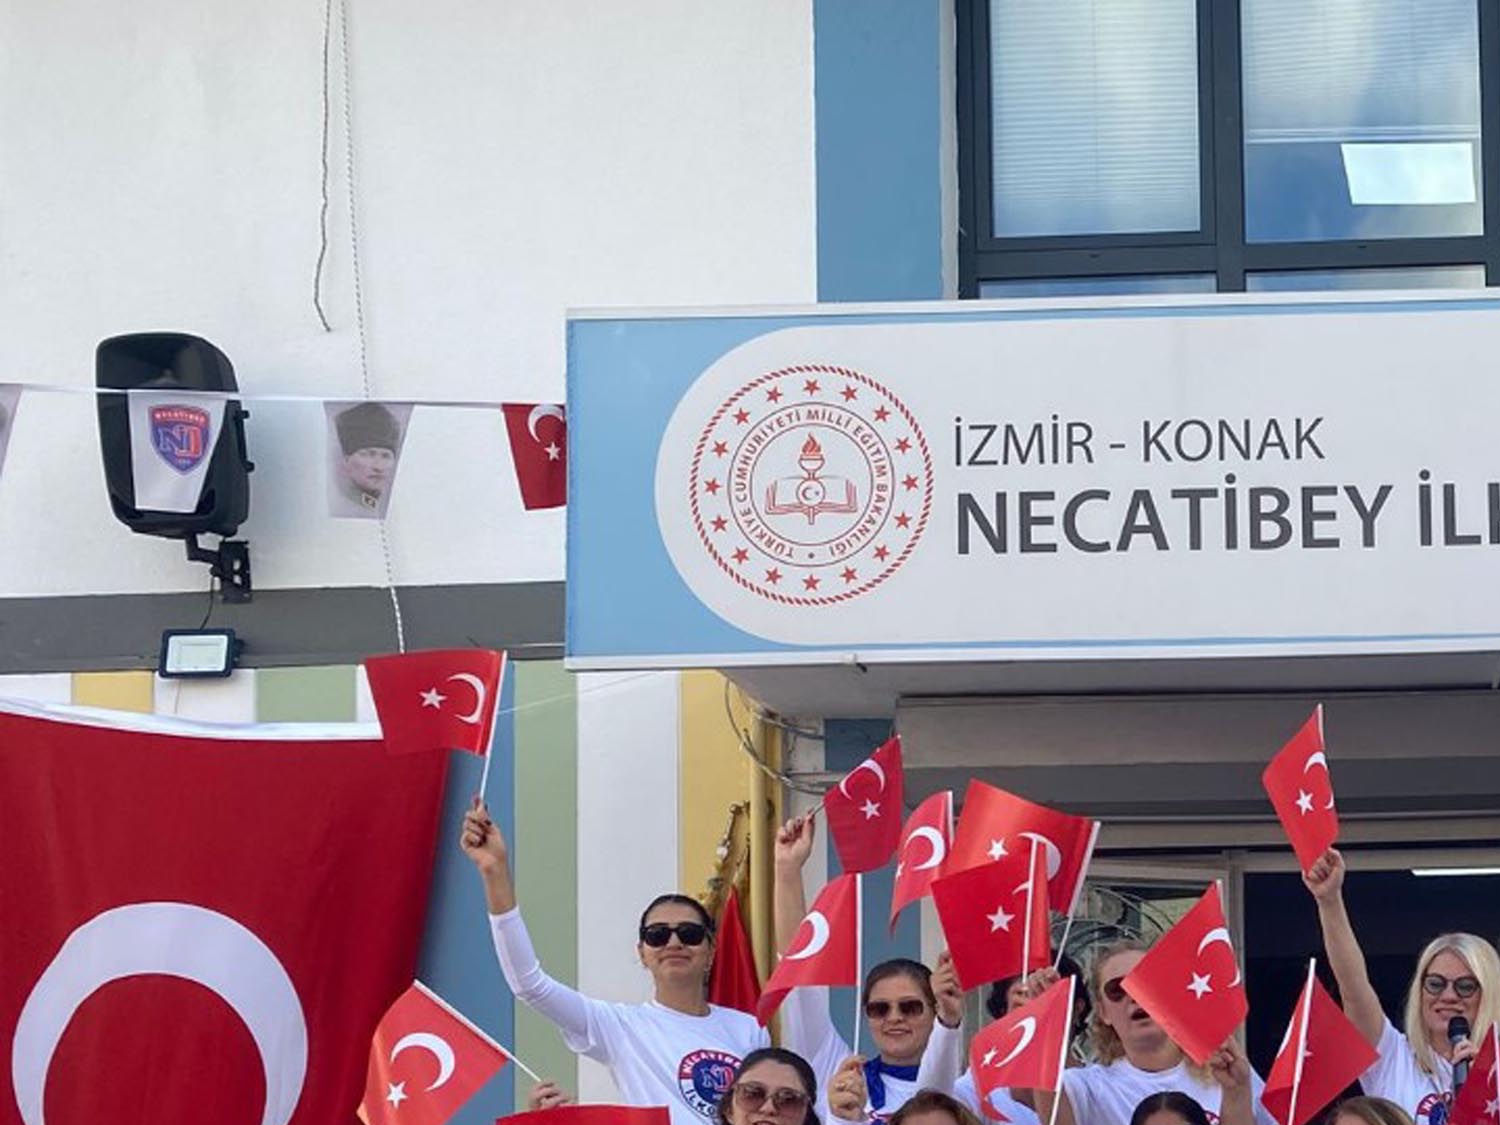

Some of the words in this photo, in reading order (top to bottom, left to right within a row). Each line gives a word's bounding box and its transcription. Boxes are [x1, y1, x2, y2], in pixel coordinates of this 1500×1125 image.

[806, 408, 851, 428] MİLLİ
[854, 426, 888, 478] EĞİTİM
[956, 414, 1093, 466] İZMİR
[1144, 418, 1324, 462] KONAK
[958, 473, 1393, 554] NECATİBEY
